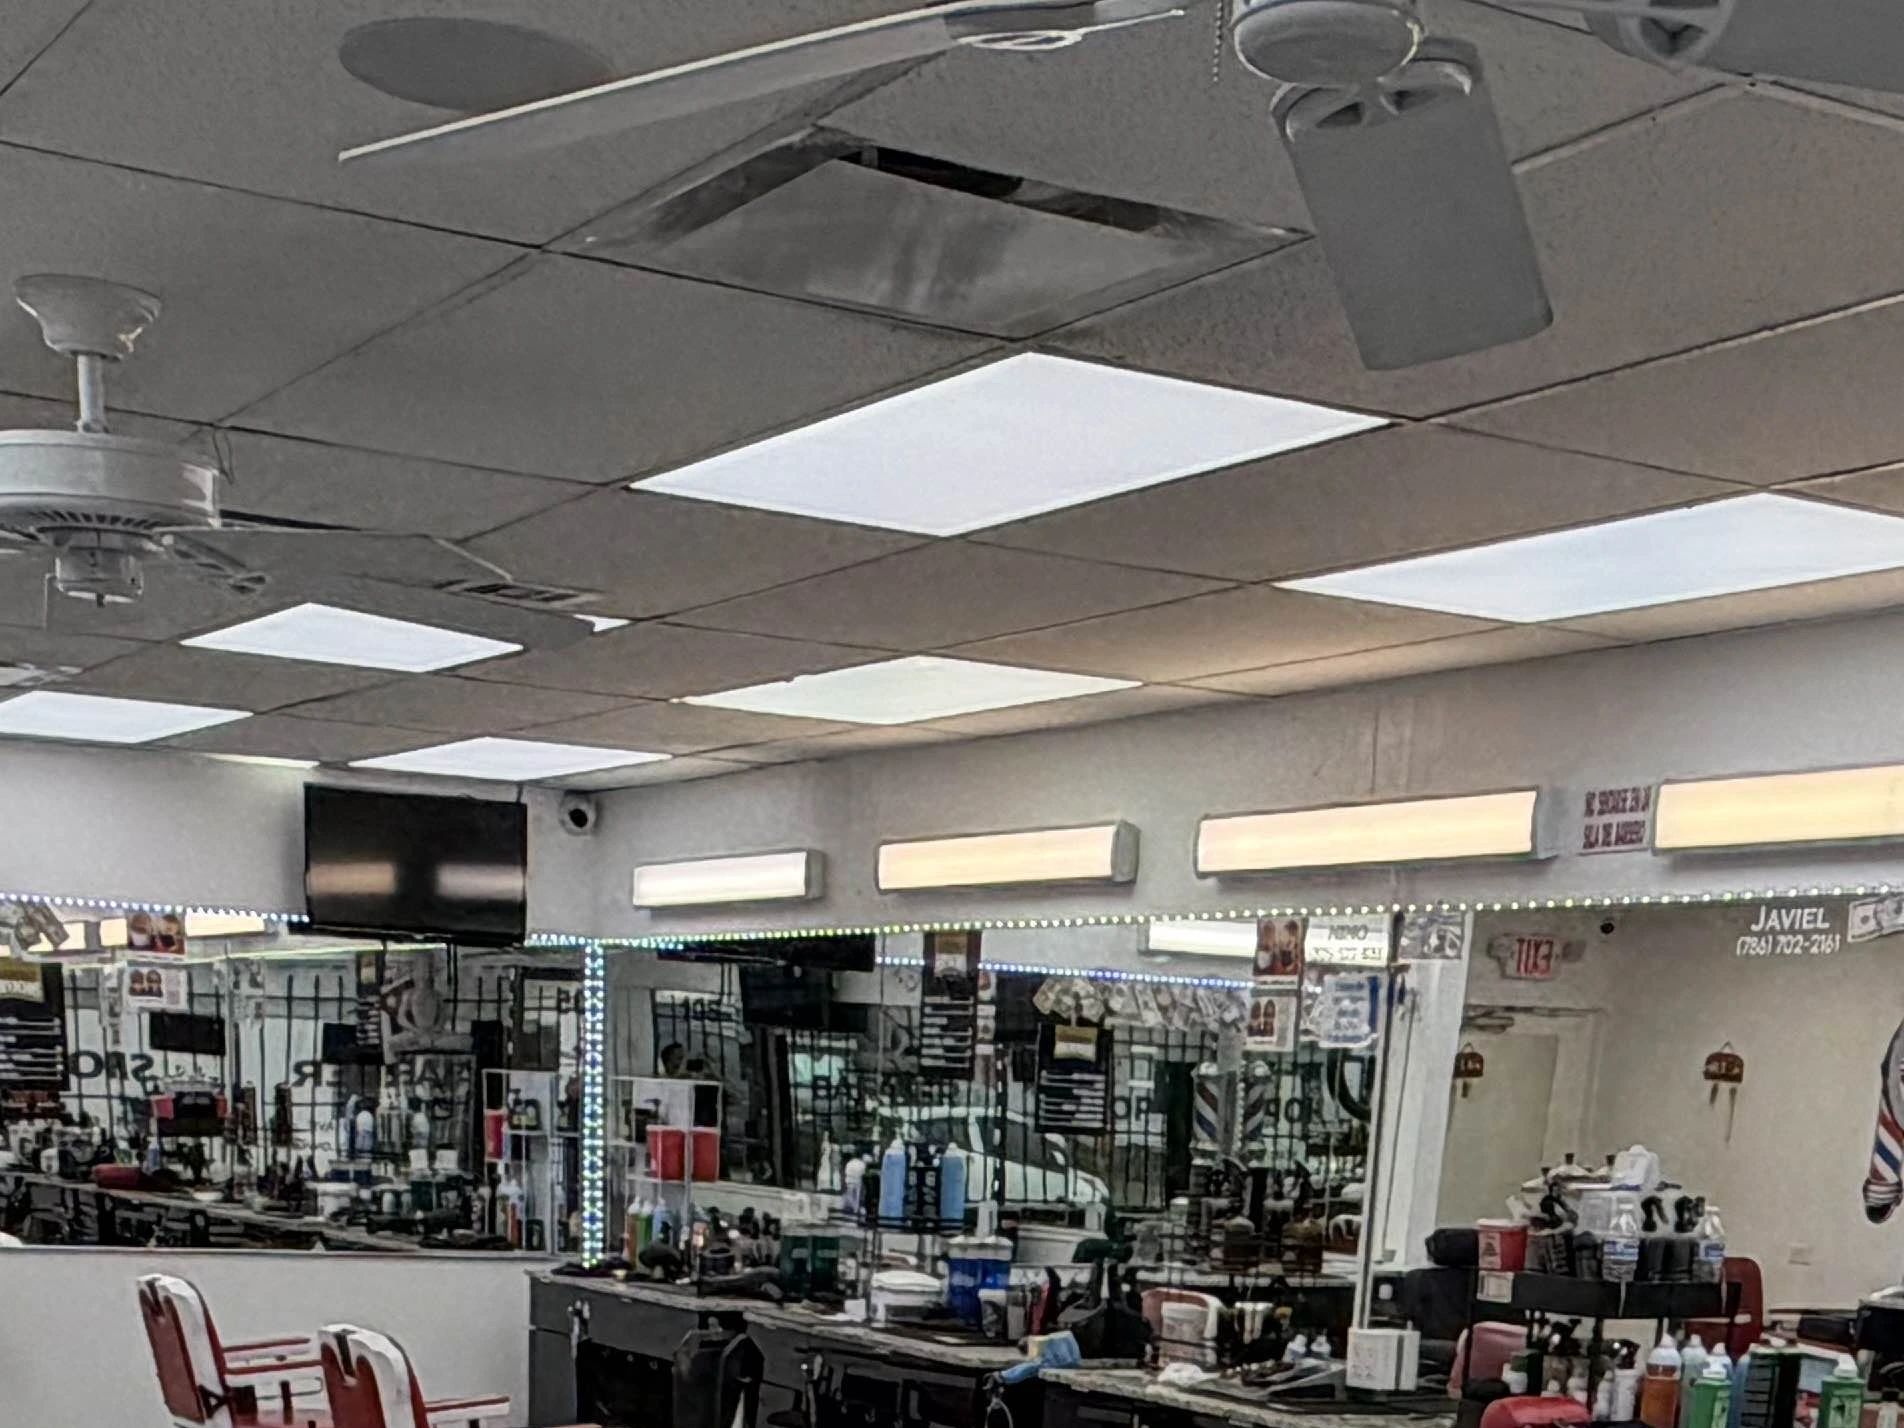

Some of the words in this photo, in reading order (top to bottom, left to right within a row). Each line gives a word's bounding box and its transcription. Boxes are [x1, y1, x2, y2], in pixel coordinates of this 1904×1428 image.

[1751, 905, 1830, 931] JAVIEL
[1736, 934, 1772, 956] (786)
[1775, 933, 1841, 955] 702-2161
